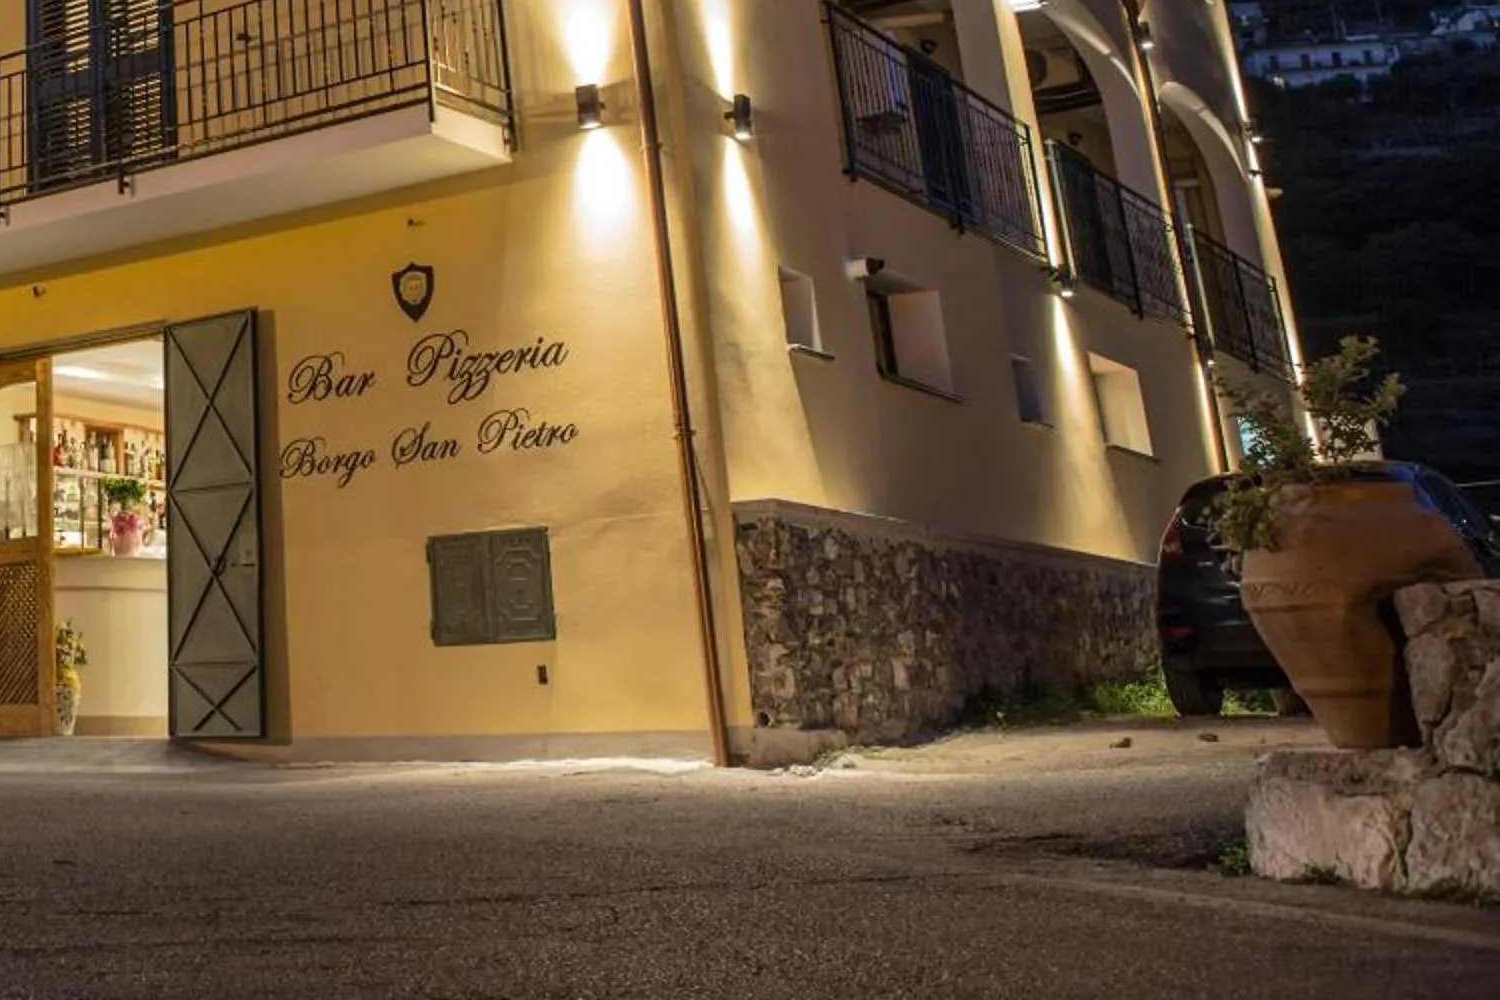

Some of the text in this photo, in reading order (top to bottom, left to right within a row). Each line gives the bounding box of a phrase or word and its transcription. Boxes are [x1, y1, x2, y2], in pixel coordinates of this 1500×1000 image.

[288, 329, 570, 405] Bar Pizzeria
[279, 407, 580, 488] Borgo San Pietro
